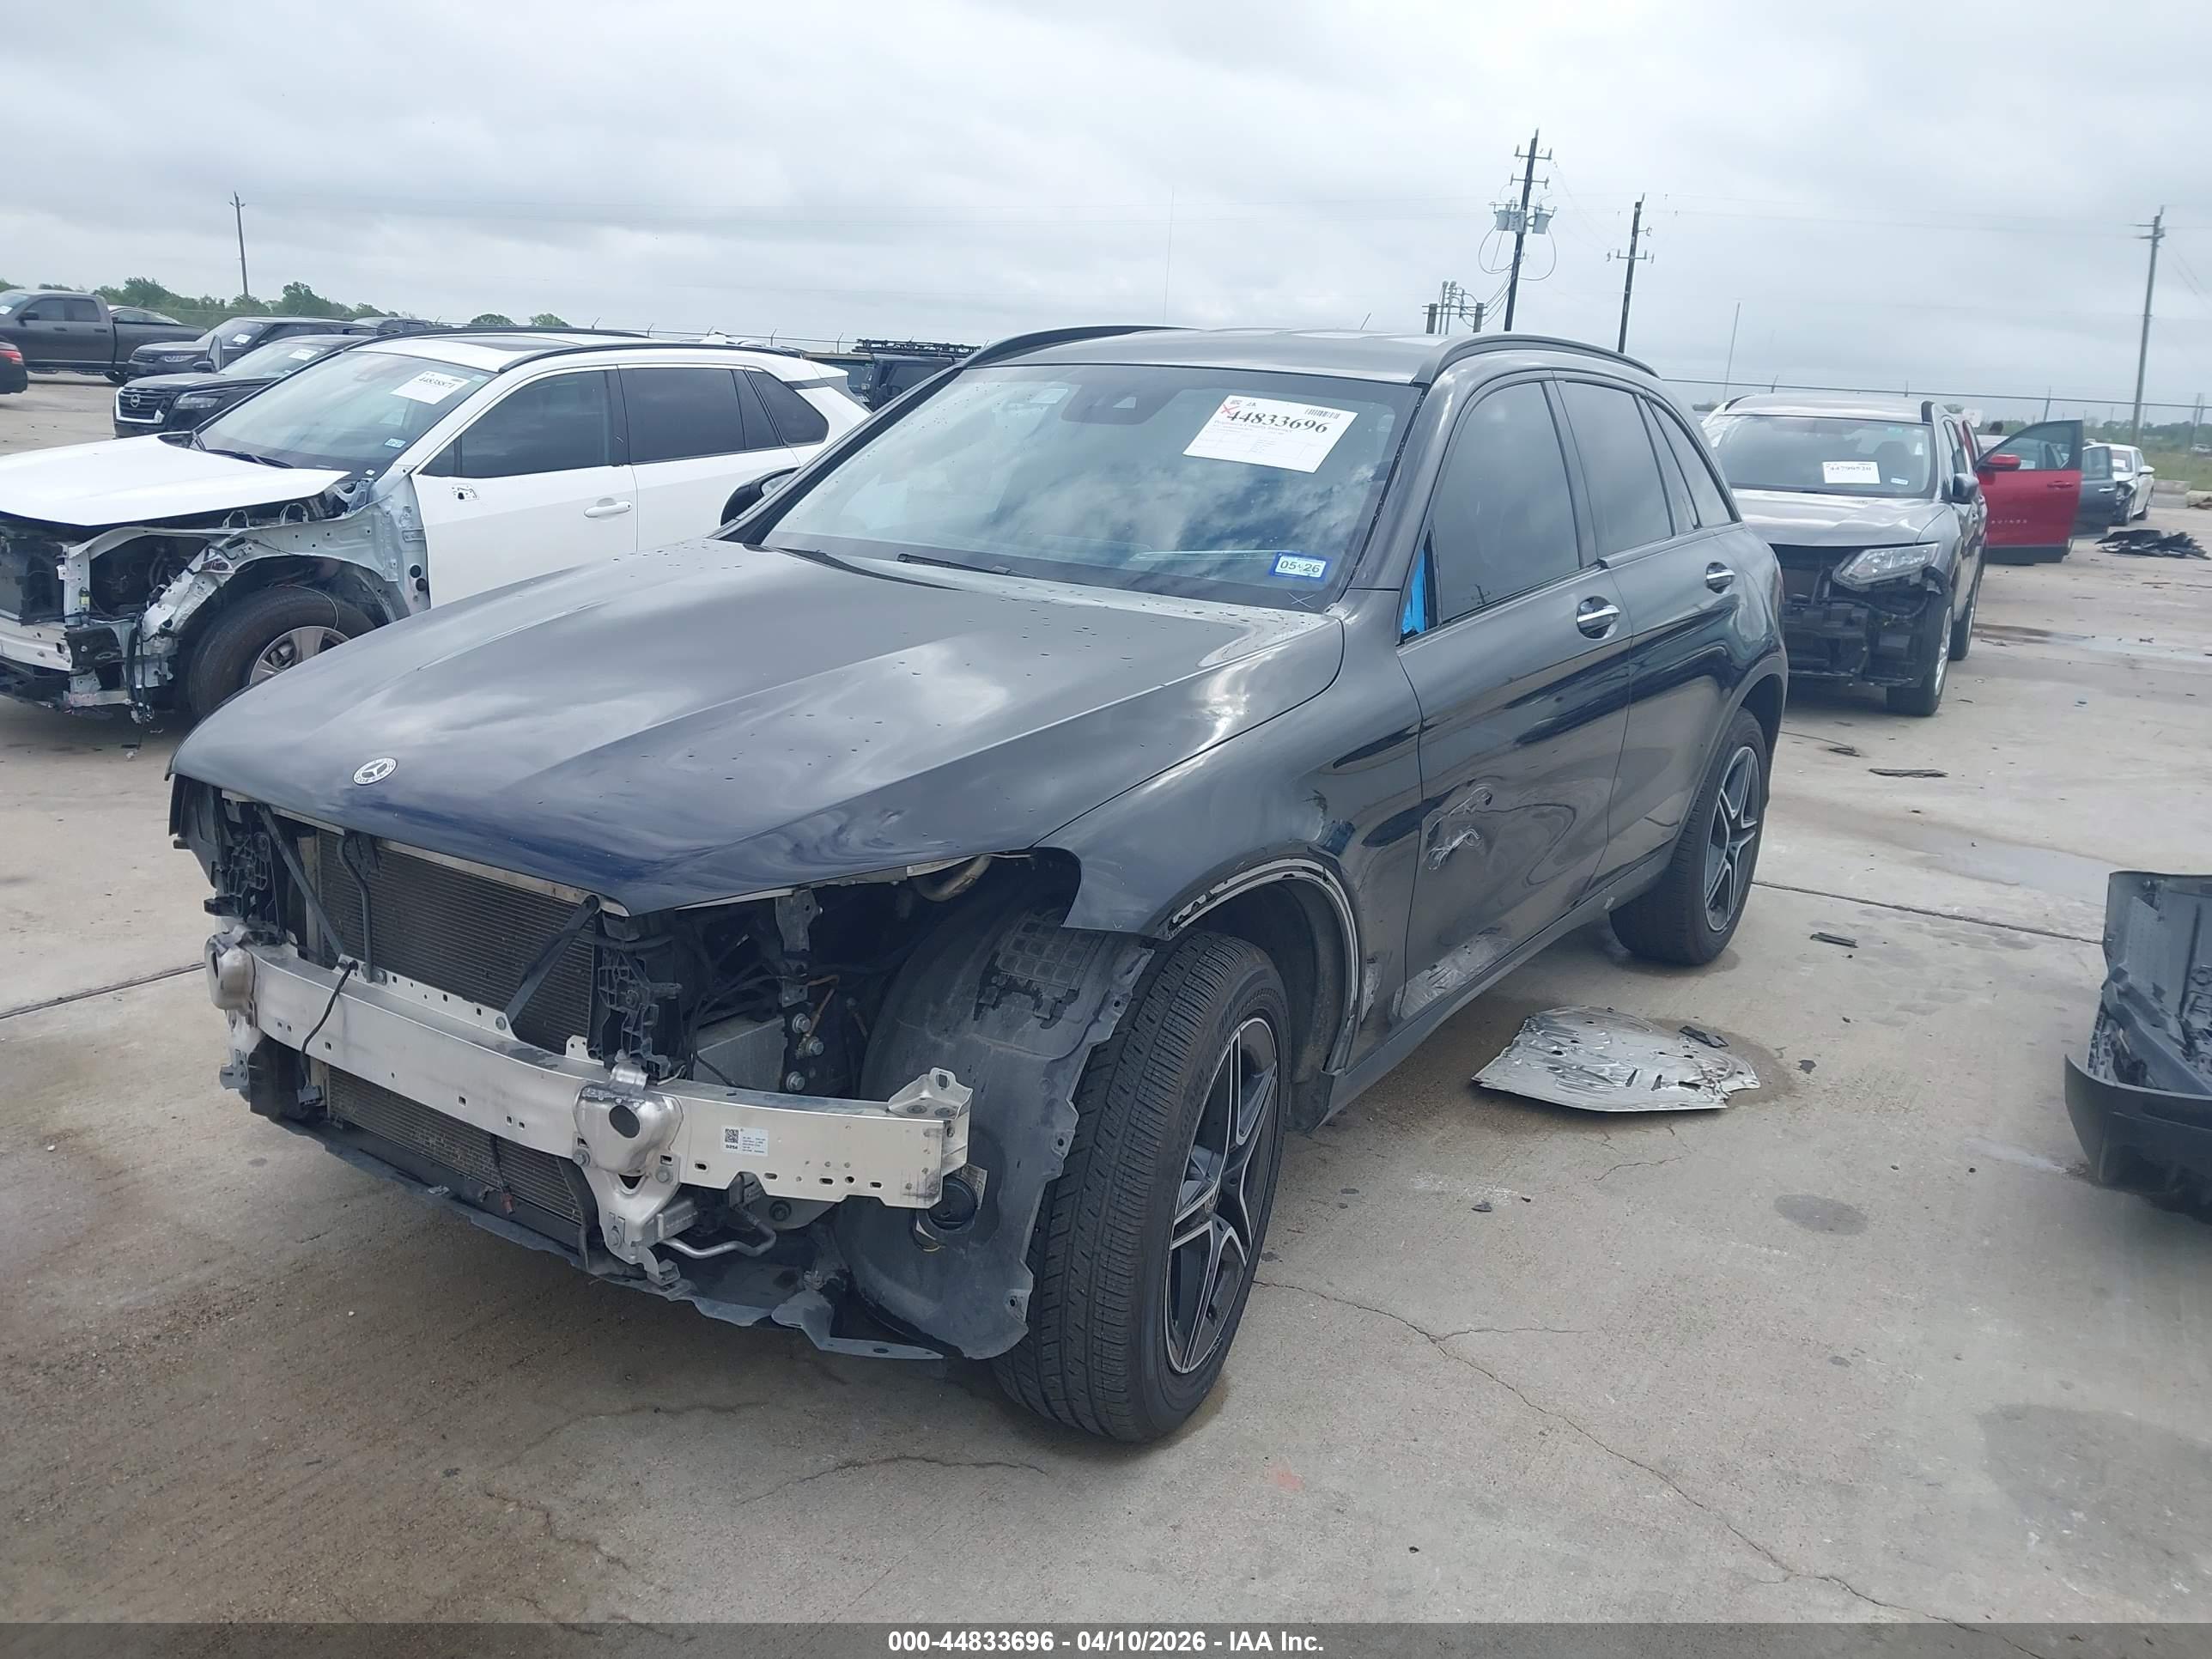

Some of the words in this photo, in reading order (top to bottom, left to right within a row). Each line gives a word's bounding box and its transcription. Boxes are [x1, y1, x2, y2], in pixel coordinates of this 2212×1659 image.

[1227, 410, 1331, 434] 44833696
[1280, 560, 1297, 570] 05
[1303, 563, 1322, 573] 26
